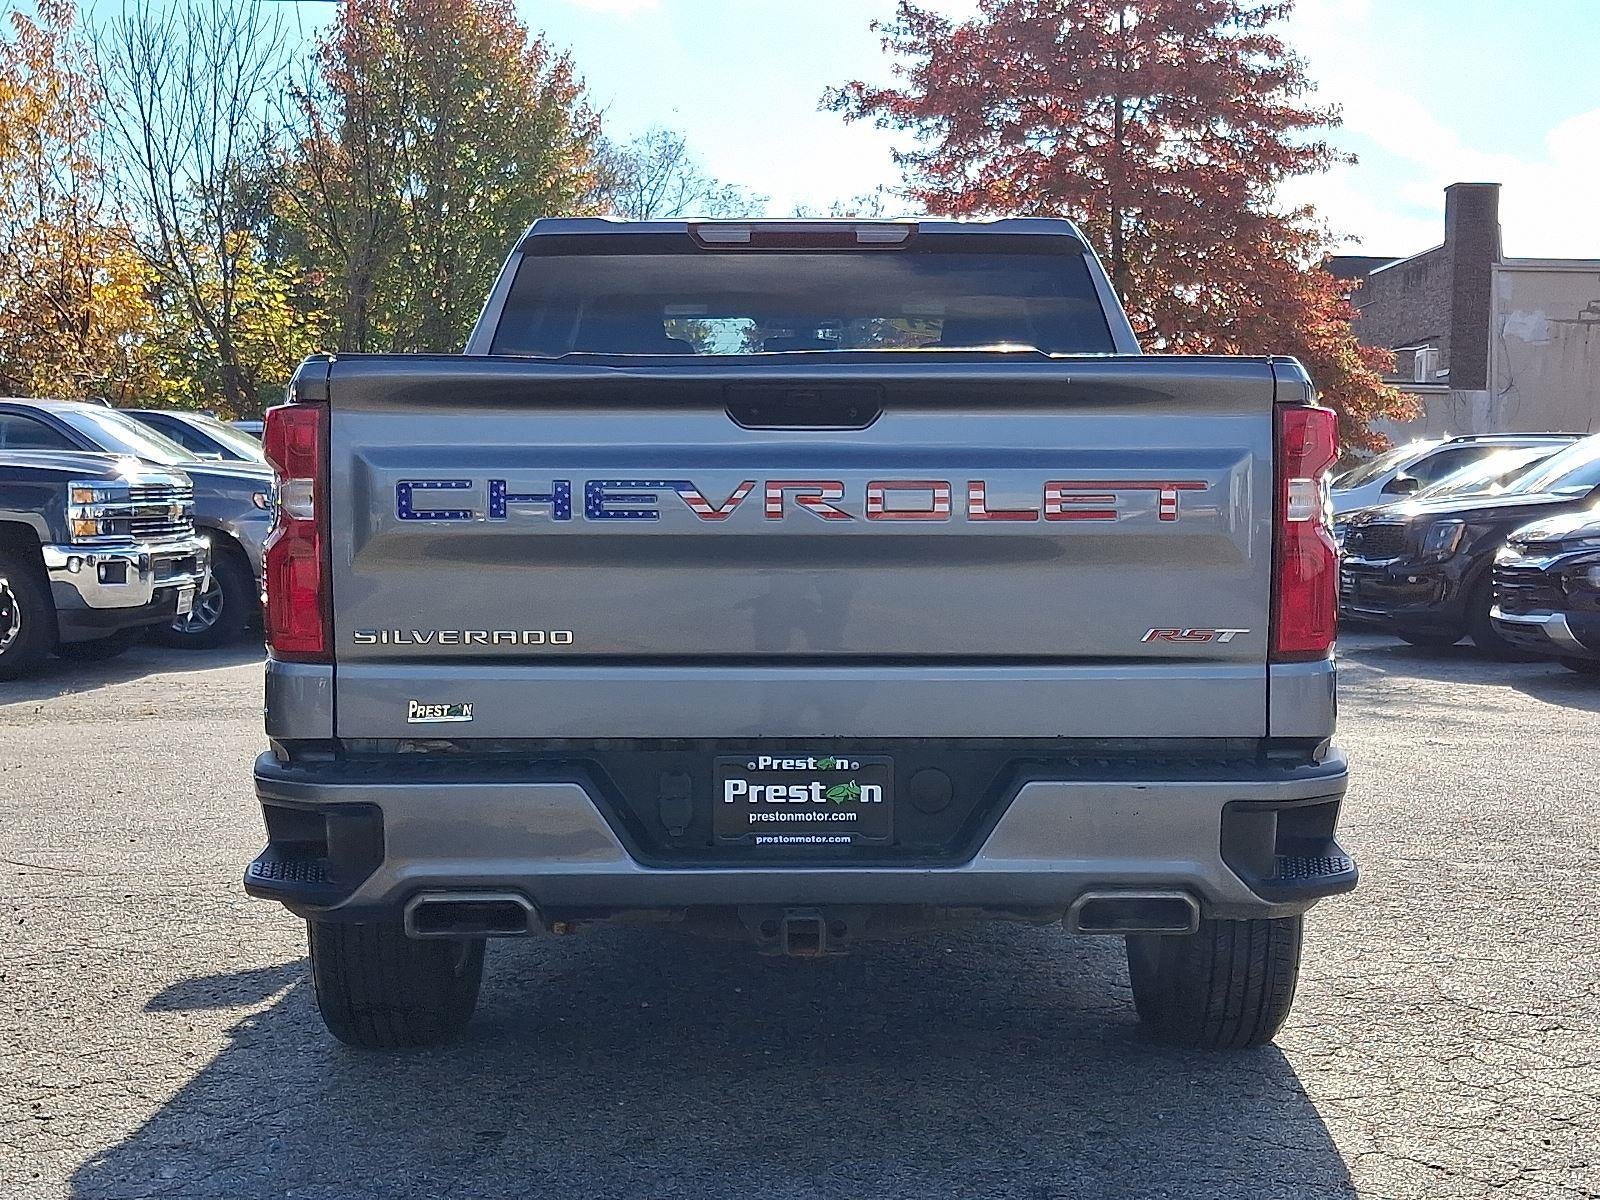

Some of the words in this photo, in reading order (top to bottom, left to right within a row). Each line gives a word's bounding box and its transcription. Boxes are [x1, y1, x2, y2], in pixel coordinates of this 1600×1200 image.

[395, 479, 1209, 523] CHEVROLET
[353, 629, 575, 645] SILVERADO
[1140, 628, 1251, 644] RST
[408, 700, 473, 718] PRESTN
[758, 755, 849, 771] Prestn
[724, 778, 883, 805] Prestn
[749, 811, 857, 824] prestonmotor.com
[756, 835, 851, 845] prestonmotor.com
